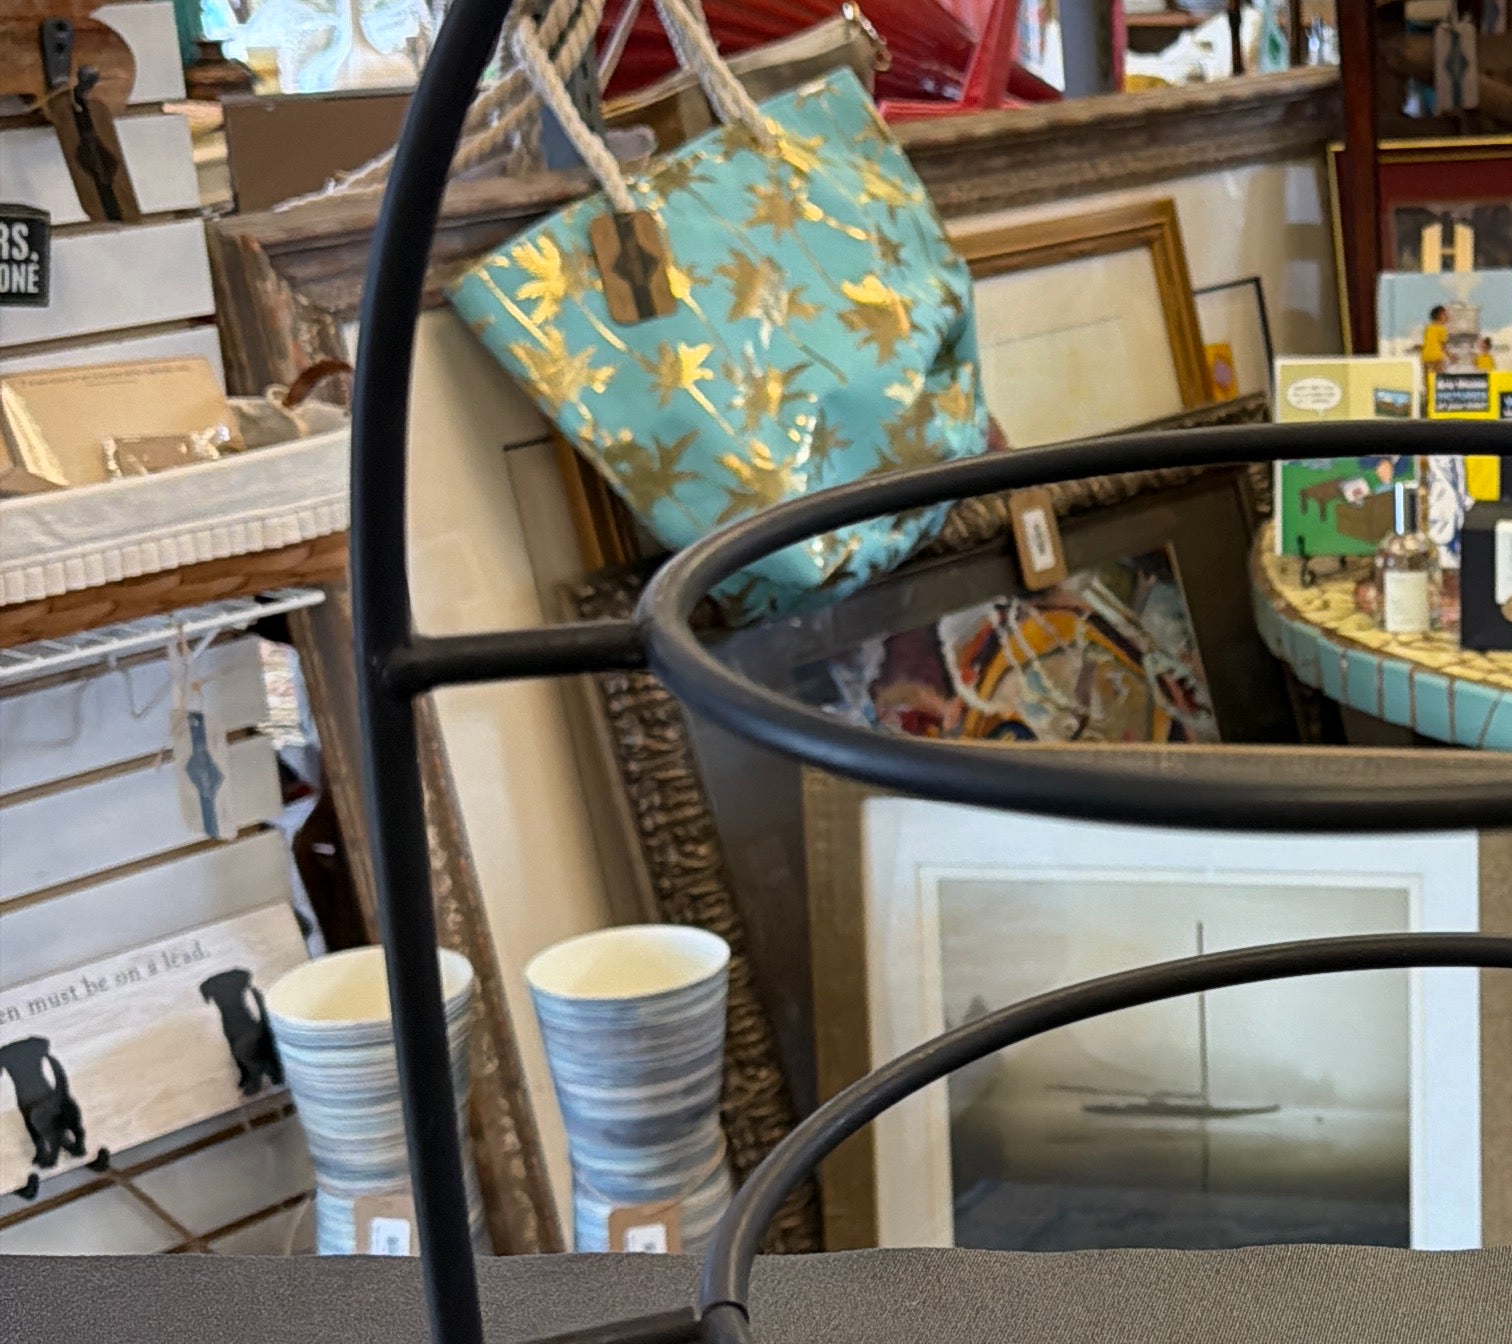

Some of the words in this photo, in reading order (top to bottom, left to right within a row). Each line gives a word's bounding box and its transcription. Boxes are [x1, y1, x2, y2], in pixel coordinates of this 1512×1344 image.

[28, 985, 81, 1016] must
[82, 975, 110, 997] be
[114, 965, 143, 987] on
